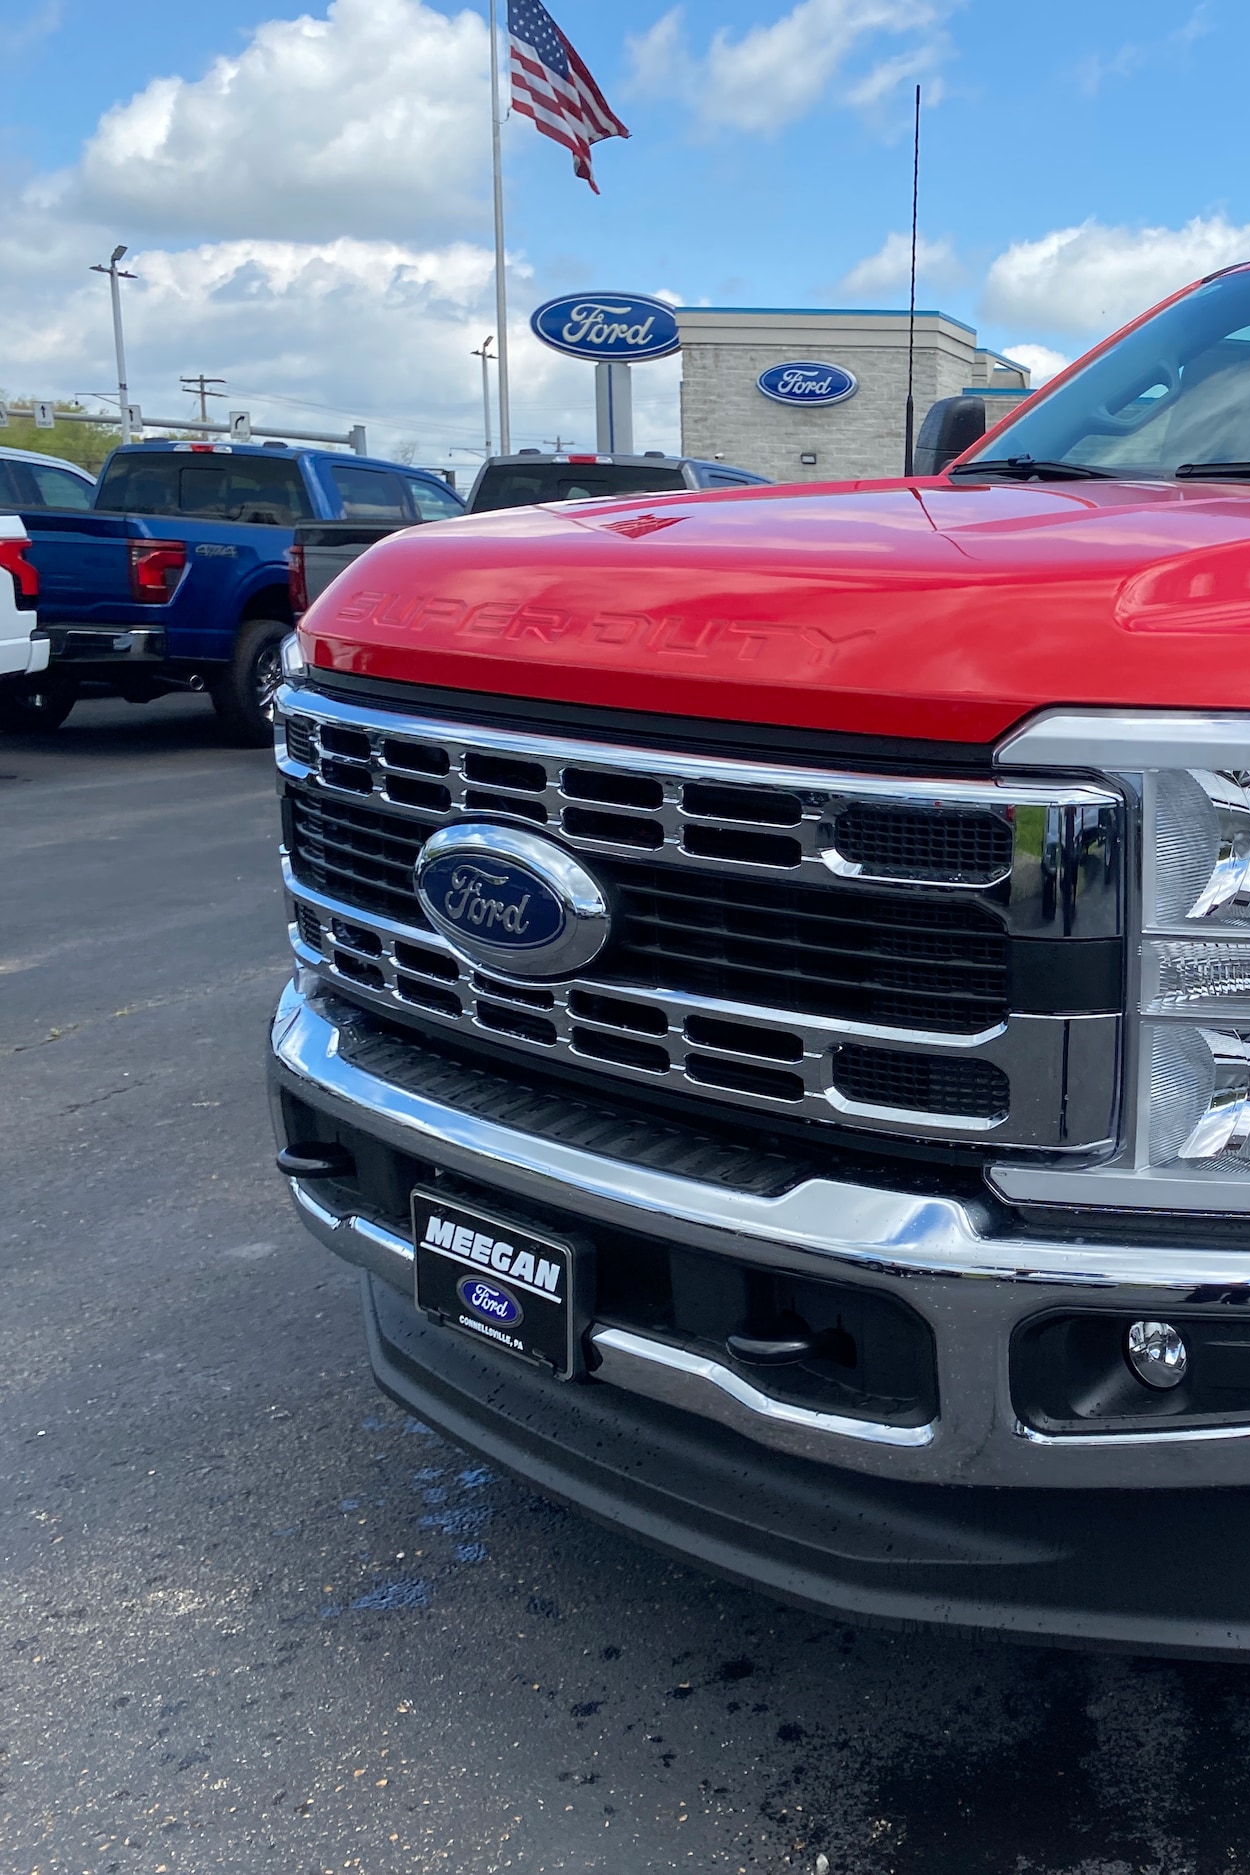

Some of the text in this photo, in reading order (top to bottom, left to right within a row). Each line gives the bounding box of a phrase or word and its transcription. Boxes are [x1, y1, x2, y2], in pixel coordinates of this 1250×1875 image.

[562, 303, 654, 345] Ford
[777, 369, 833, 395] Ford
[336, 590, 876, 668] SUPER DUTY
[444, 864, 531, 935] Ford
[425, 1215, 561, 1293] MEEGAN
[472, 1284, 508, 1318] Ford
[459, 1315, 524, 1351] CONNELLSVILLE, PA
